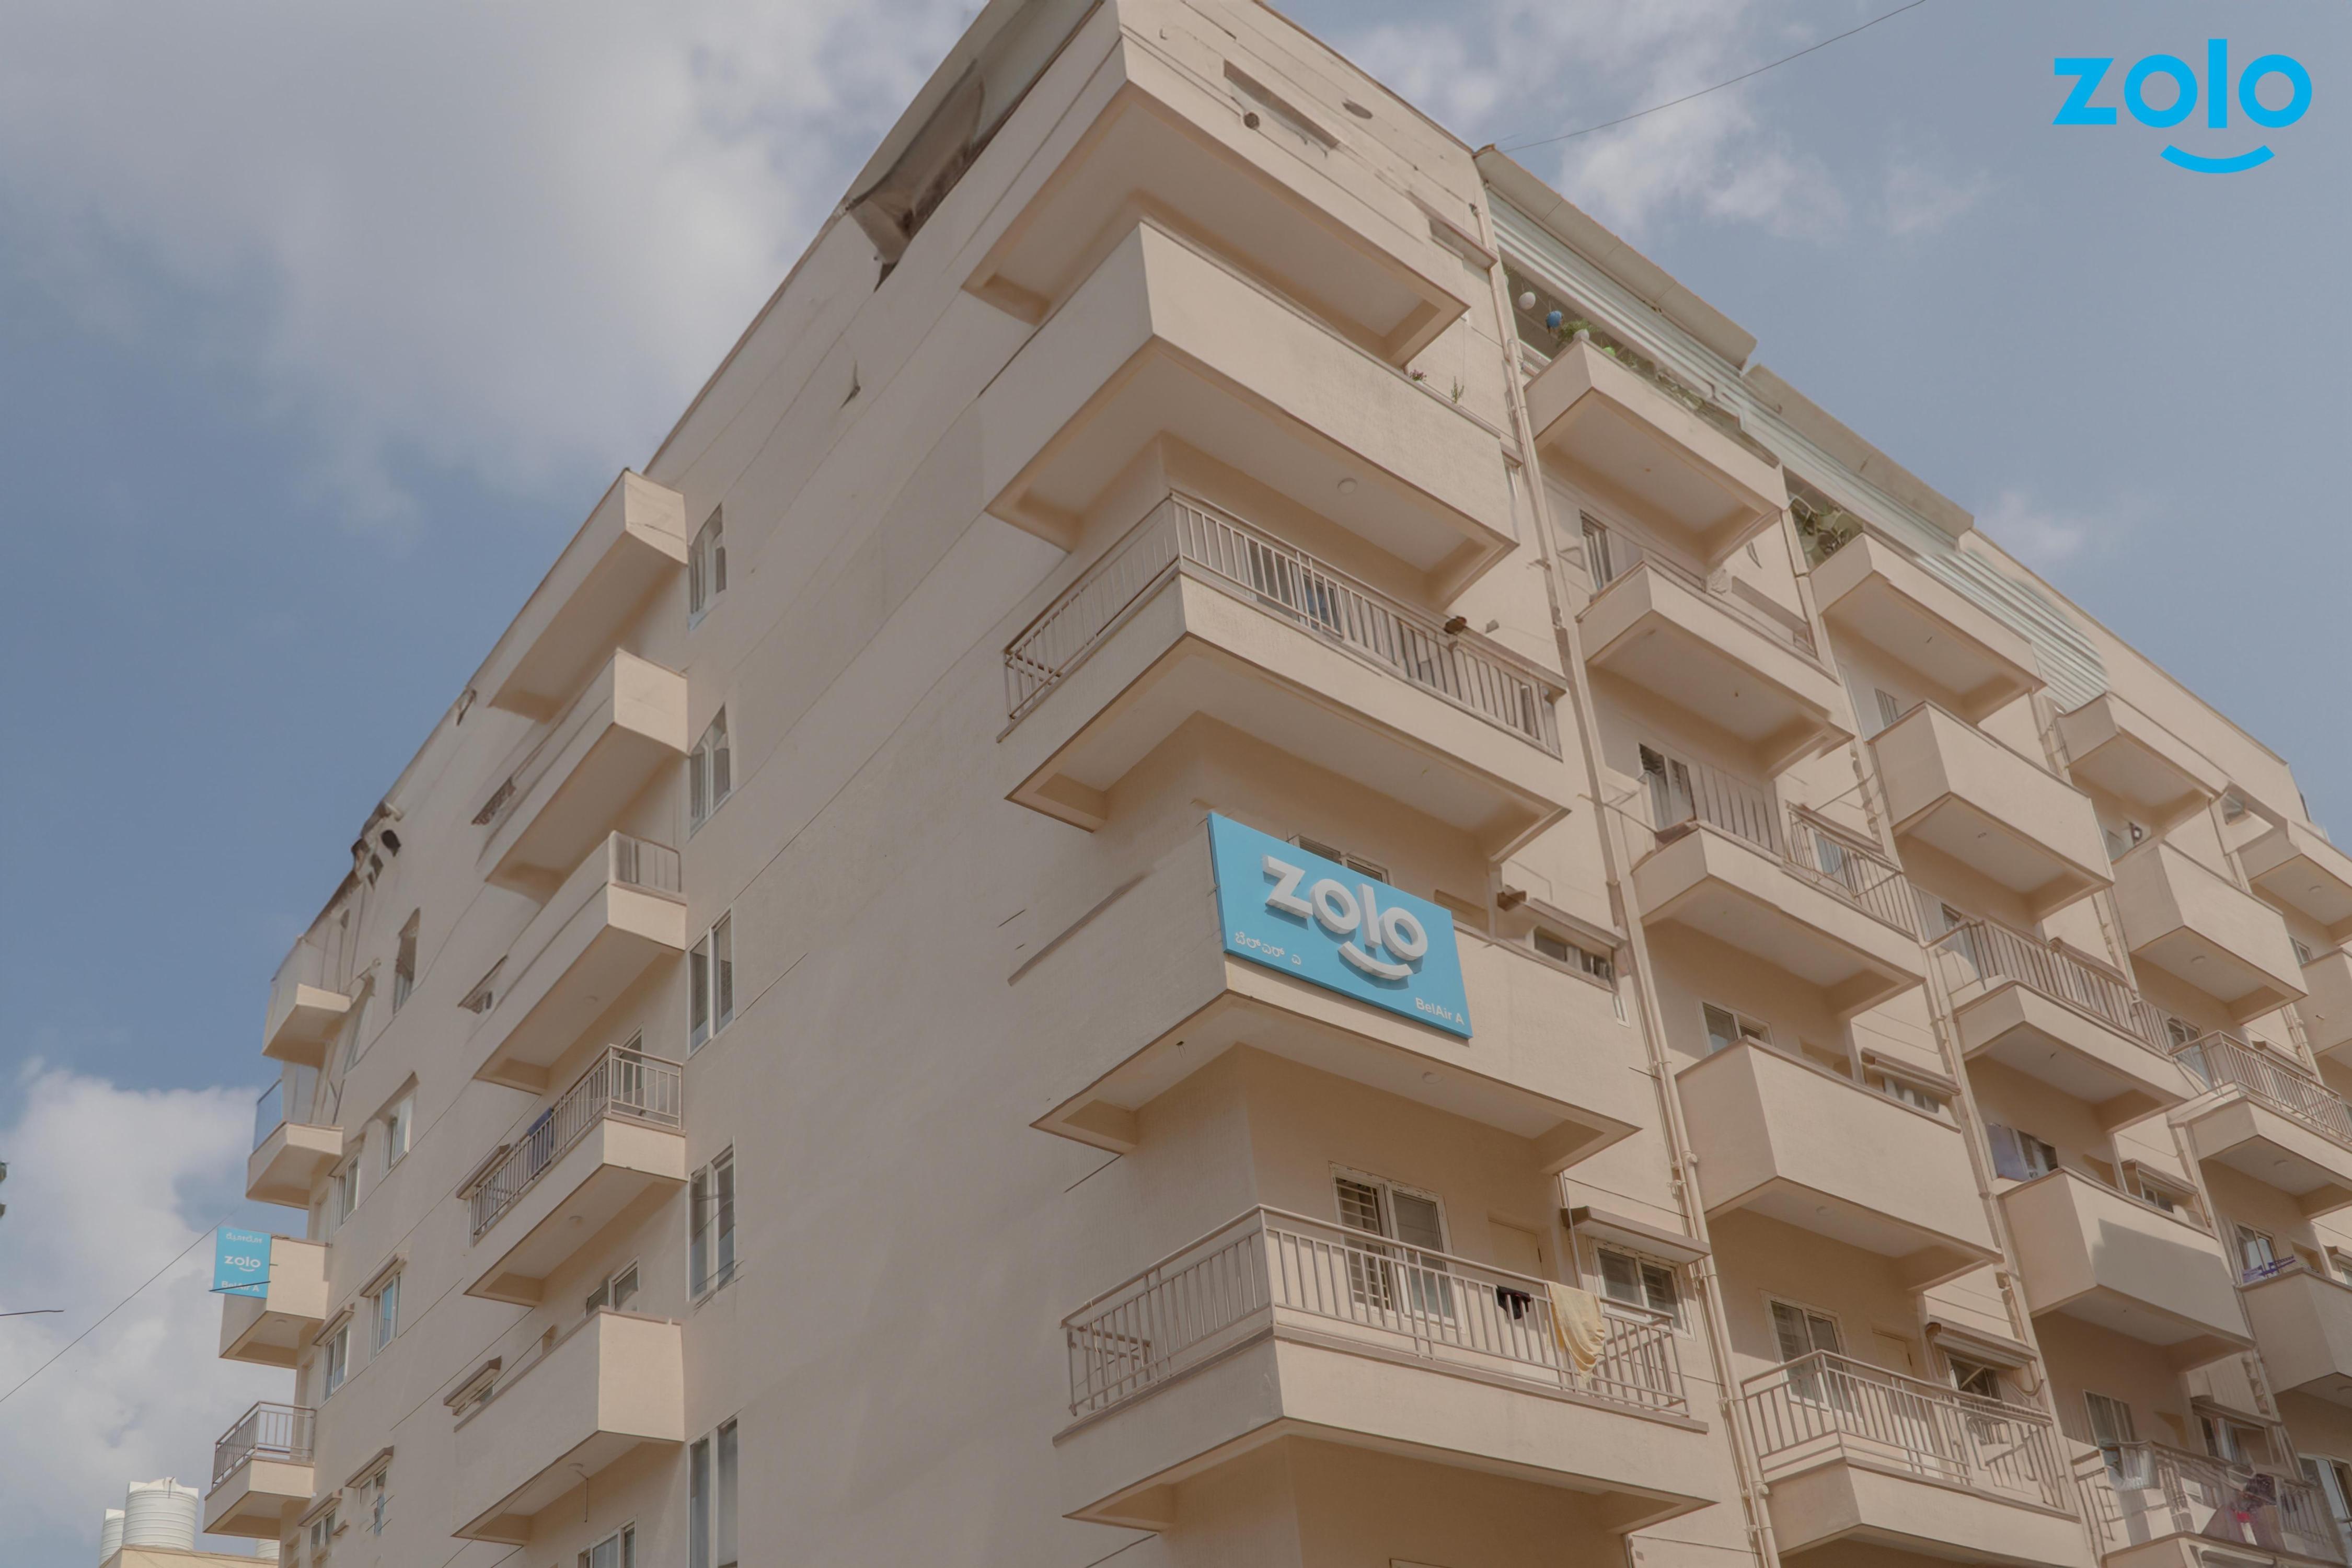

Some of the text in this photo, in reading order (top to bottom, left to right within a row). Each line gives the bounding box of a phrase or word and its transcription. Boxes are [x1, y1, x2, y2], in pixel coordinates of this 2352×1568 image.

[1263, 855, 1428, 961] zolo
[1415, 997, 1465, 1025] BelAir A
[224, 1255, 261, 1268] zolo
